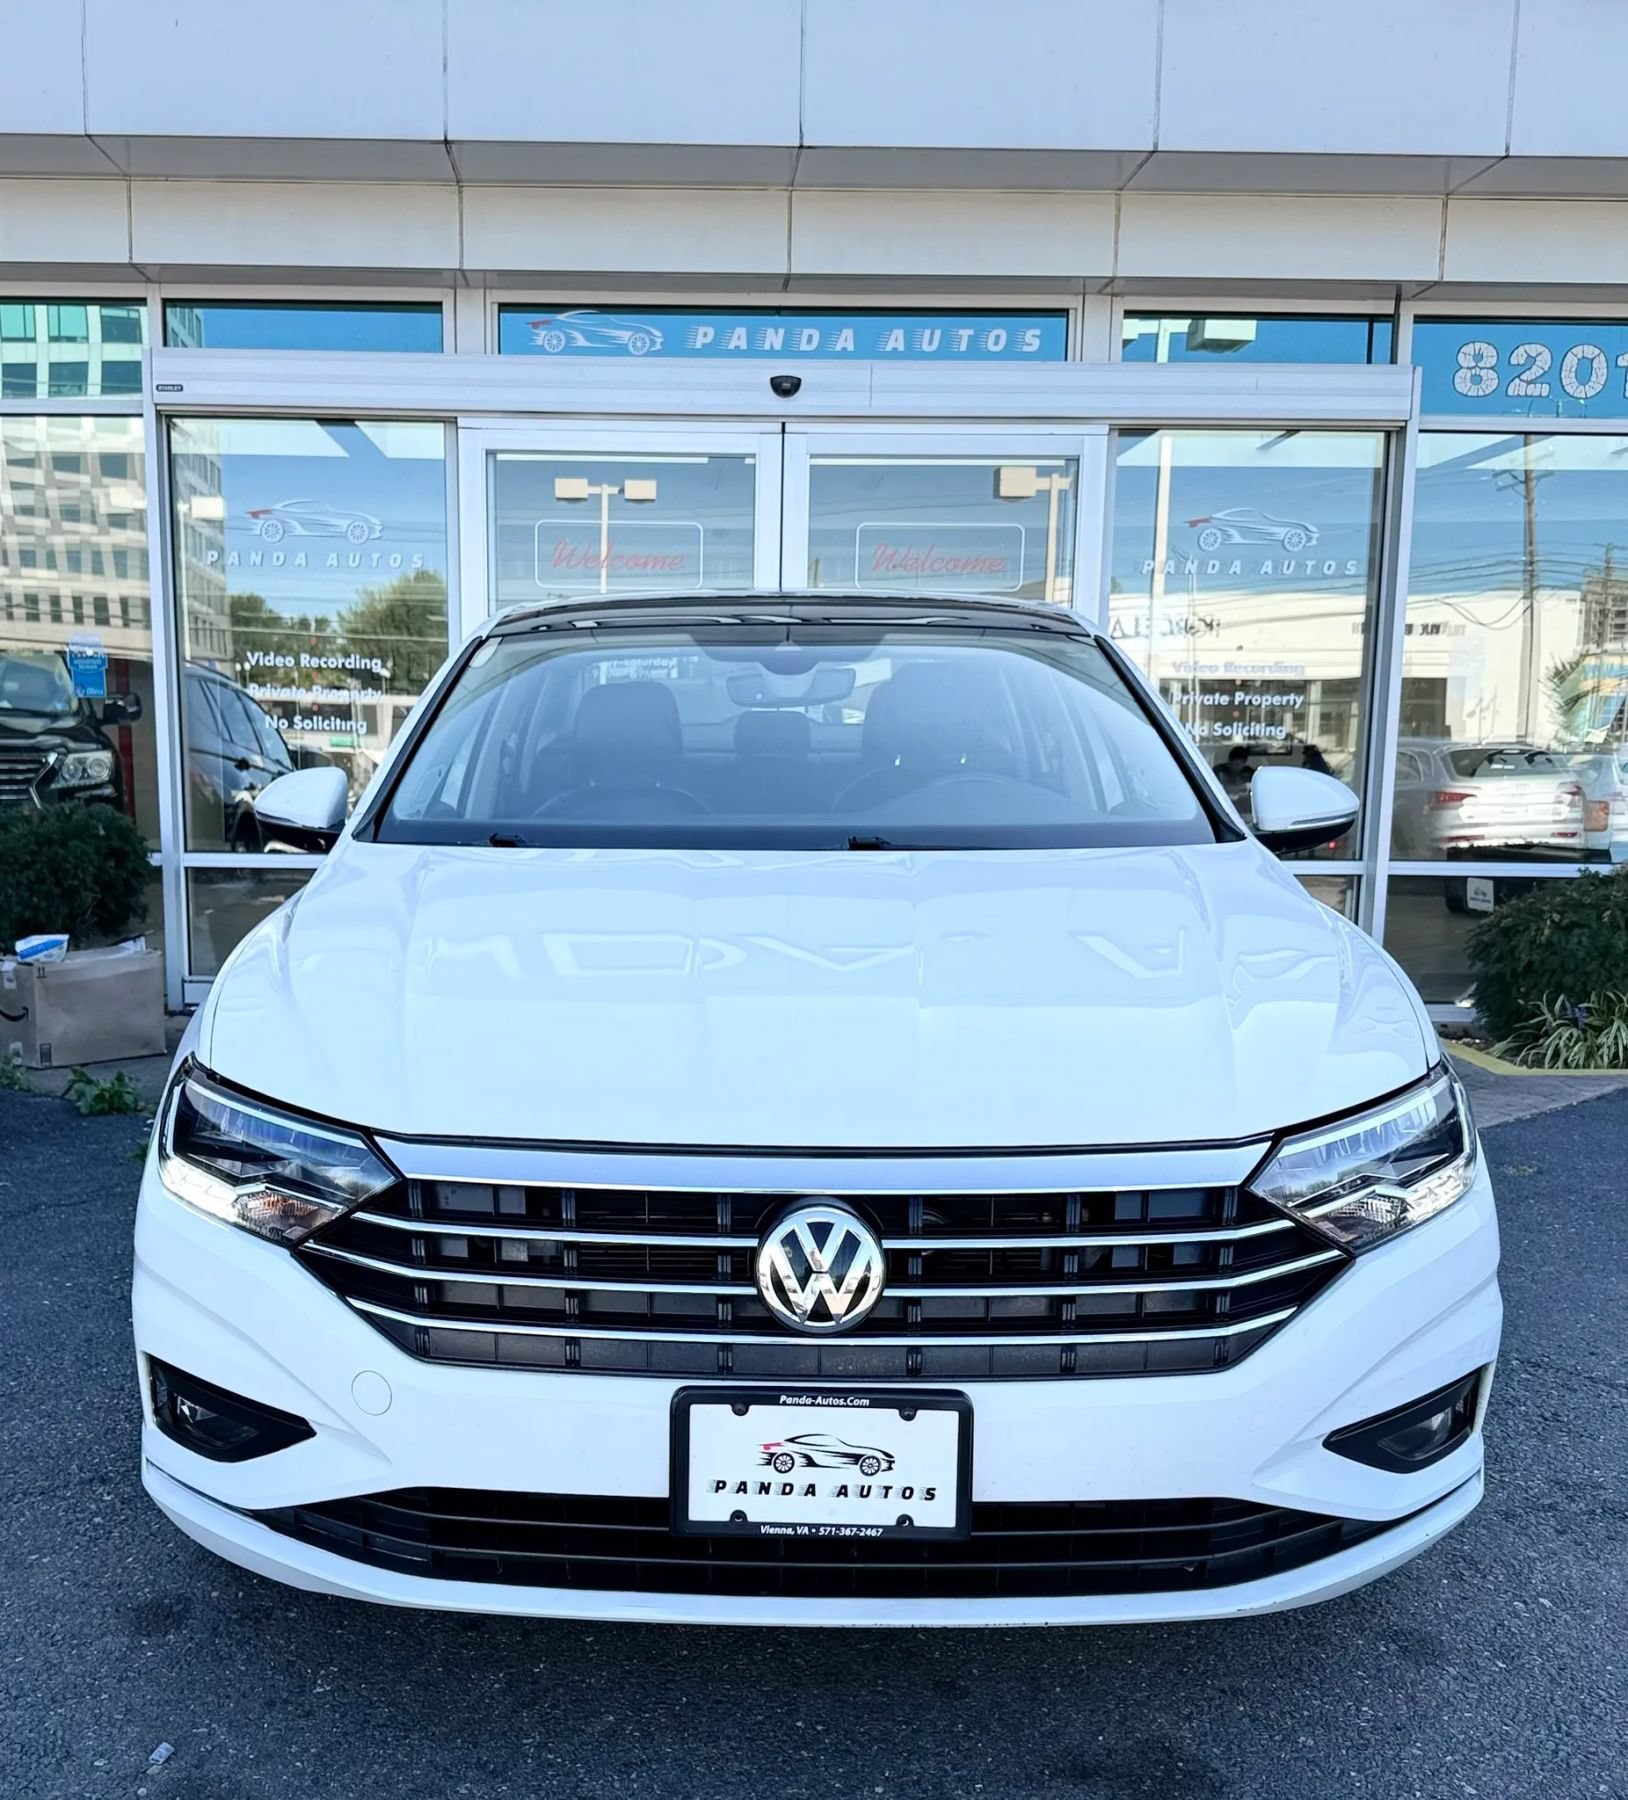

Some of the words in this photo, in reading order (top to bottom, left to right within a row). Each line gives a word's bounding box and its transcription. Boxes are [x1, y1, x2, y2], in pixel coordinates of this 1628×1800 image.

[687, 326, 855, 351] PANDA
[878, 328, 1042, 352] AUTOS
[207, 550, 309, 567] PANDA
[326, 552, 424, 569] AUTOS
[552, 538, 687, 571] Welcome
[871, 543, 1006, 573] Welcome
[1141, 559, 1242, 575] PANDA
[1260, 559, 1358, 576] AUTOS
[246, 652, 295, 667] Video
[300, 653, 382, 672] Recording
[1172, 661, 1219, 674] Video
[1224, 661, 1306, 676] Recording
[250, 683, 307, 698] Private
[312, 685, 382, 703] Property
[1172, 690, 1230, 706] Private
[1235, 691, 1304, 709] Property
[265, 714, 288, 729] No
[294, 715, 367, 734] Soliciting
[1183, 722, 1208, 737] No
[1213, 722, 1287, 739] Soliciting
[779, 1394, 870, 1407] Panda-Autos.Com
[709, 1479, 816, 1498] PANDA
[833, 1484, 937, 1501] AUTOS
[760, 1525, 795, 1536] Vienna,
[796, 1527, 810, 1536] VA
[818, 1527, 884, 1538] 571-367-2467
